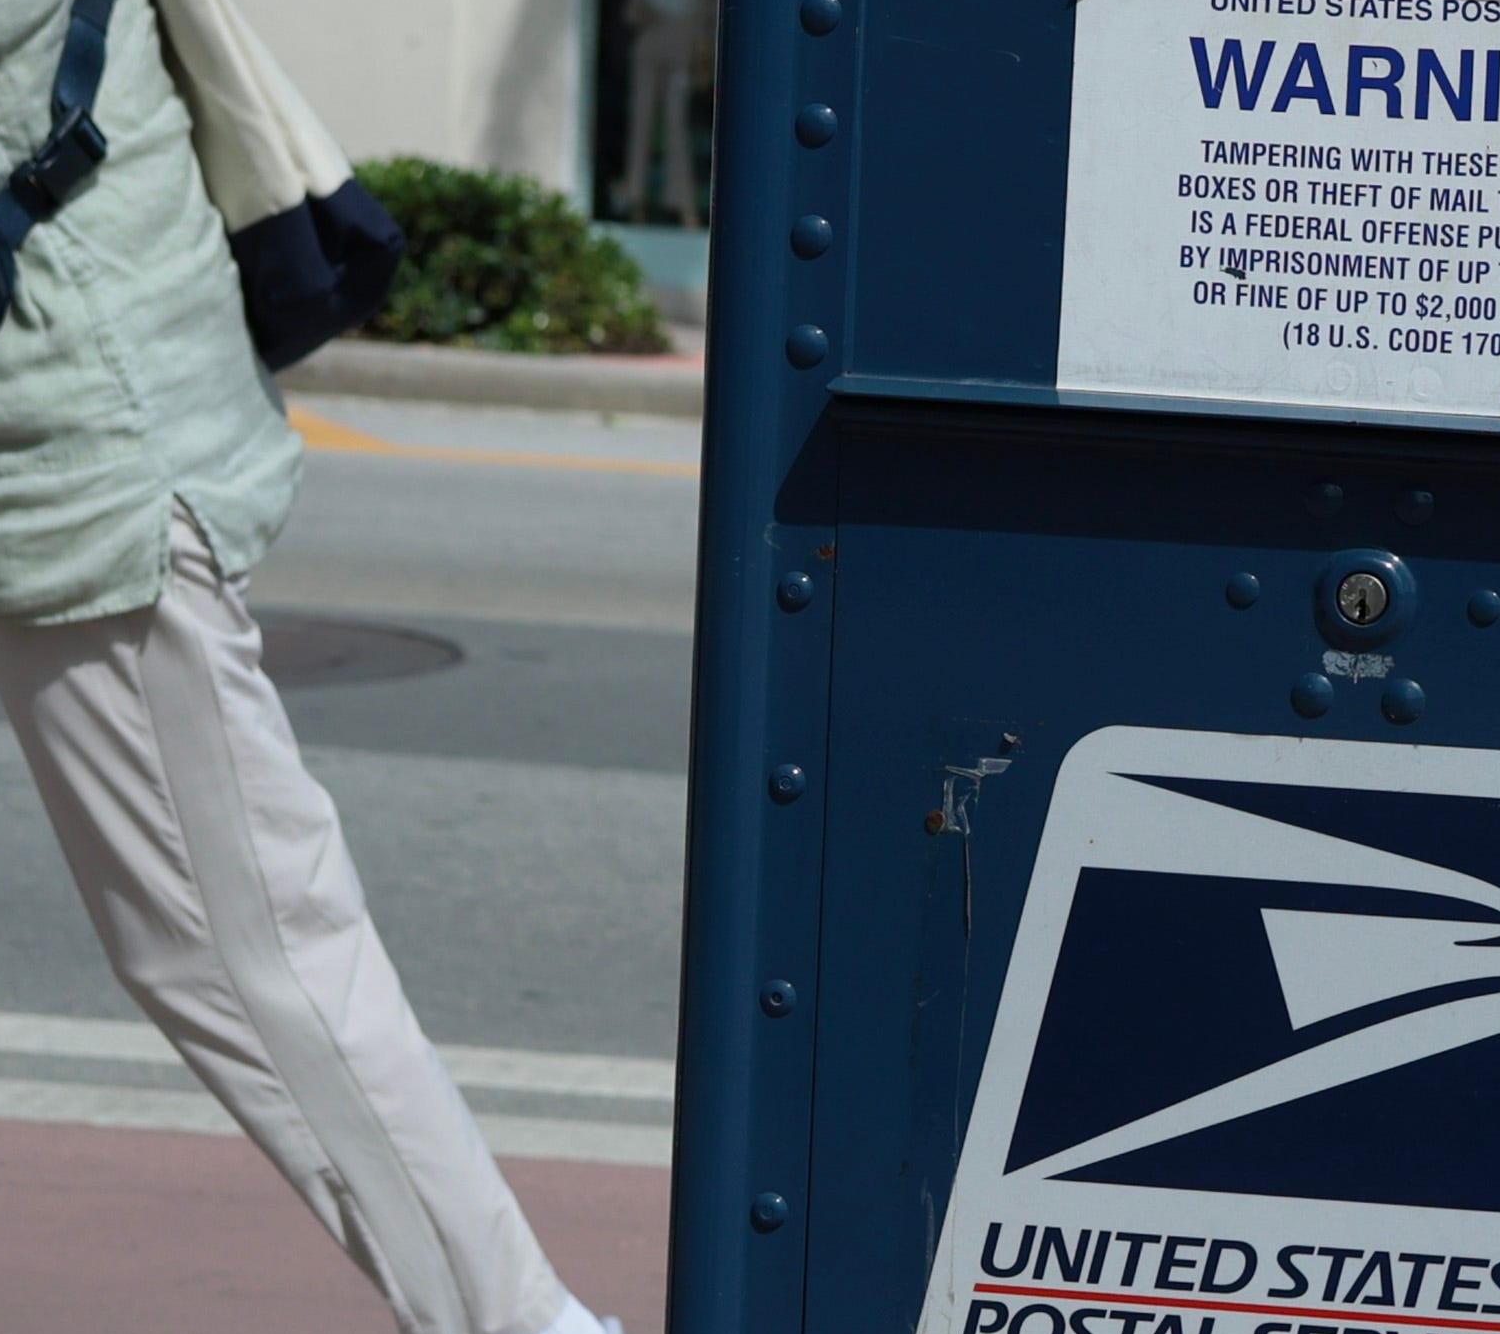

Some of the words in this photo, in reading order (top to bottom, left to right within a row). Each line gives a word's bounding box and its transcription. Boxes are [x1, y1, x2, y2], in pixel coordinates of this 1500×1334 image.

[1200, 139, 1341, 170] TAMPERING
[1350, 148, 1413, 174] WITH
[1421, 151, 1498, 177] THESE
[1178, 174, 1256, 201] BOXES
[1265, 178, 1298, 204] OR
[1307, 181, 1383, 208] THEFT
[1390, 185, 1422, 210] OF
[1429, 187, 1489, 213] MAIL
[1191, 210, 1213, 234] IS
[1221, 212, 1237, 236] A
[1245, 213, 1353, 242] FEDERAL
[1362, 219, 1470, 248] OFFENSE
[1180, 245, 1211, 269] BY
[1219, 247, 1411, 280] IMPRISONMENT
[1418, 258, 1450, 282] OF
[1458, 260, 1490, 284] UP
[1193, 280, 1226, 306] OR
[1235, 283, 1289, 309] FINE
[1297, 286, 1328, 311] OF
[1336, 289, 1369, 314] UP
[1376, 291, 1407, 316] TO
[1415, 292, 1497, 321] $2,000
[1283, 321, 1320, 350] (18
[1329, 324, 1378, 350] U.S.
[1388, 327, 1453, 354] CODE
[980, 1222, 1258, 1294] UNITED
